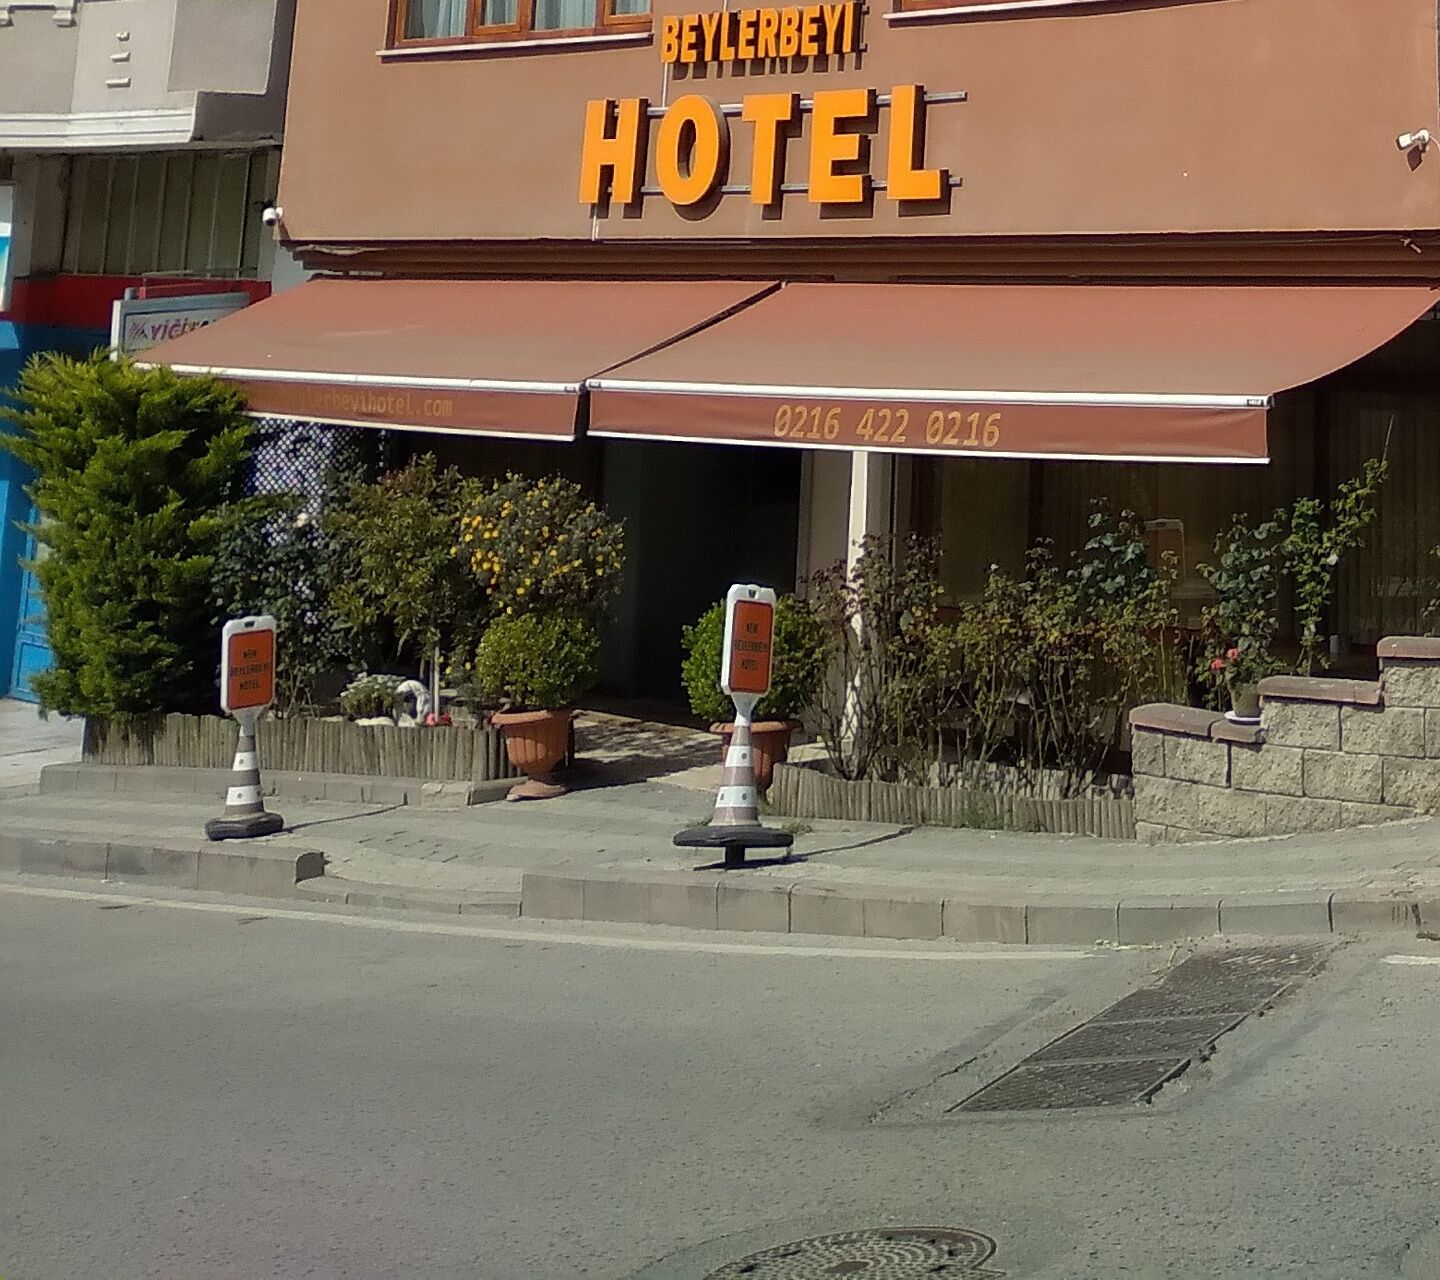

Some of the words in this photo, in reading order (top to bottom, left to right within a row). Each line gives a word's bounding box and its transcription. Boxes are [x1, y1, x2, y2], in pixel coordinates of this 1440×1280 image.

[578, 83, 946, 207] HOTEL
[773, 404, 842, 441] 0216
[855, 407, 910, 444] 422
[925, 409, 1002, 448] 0216
